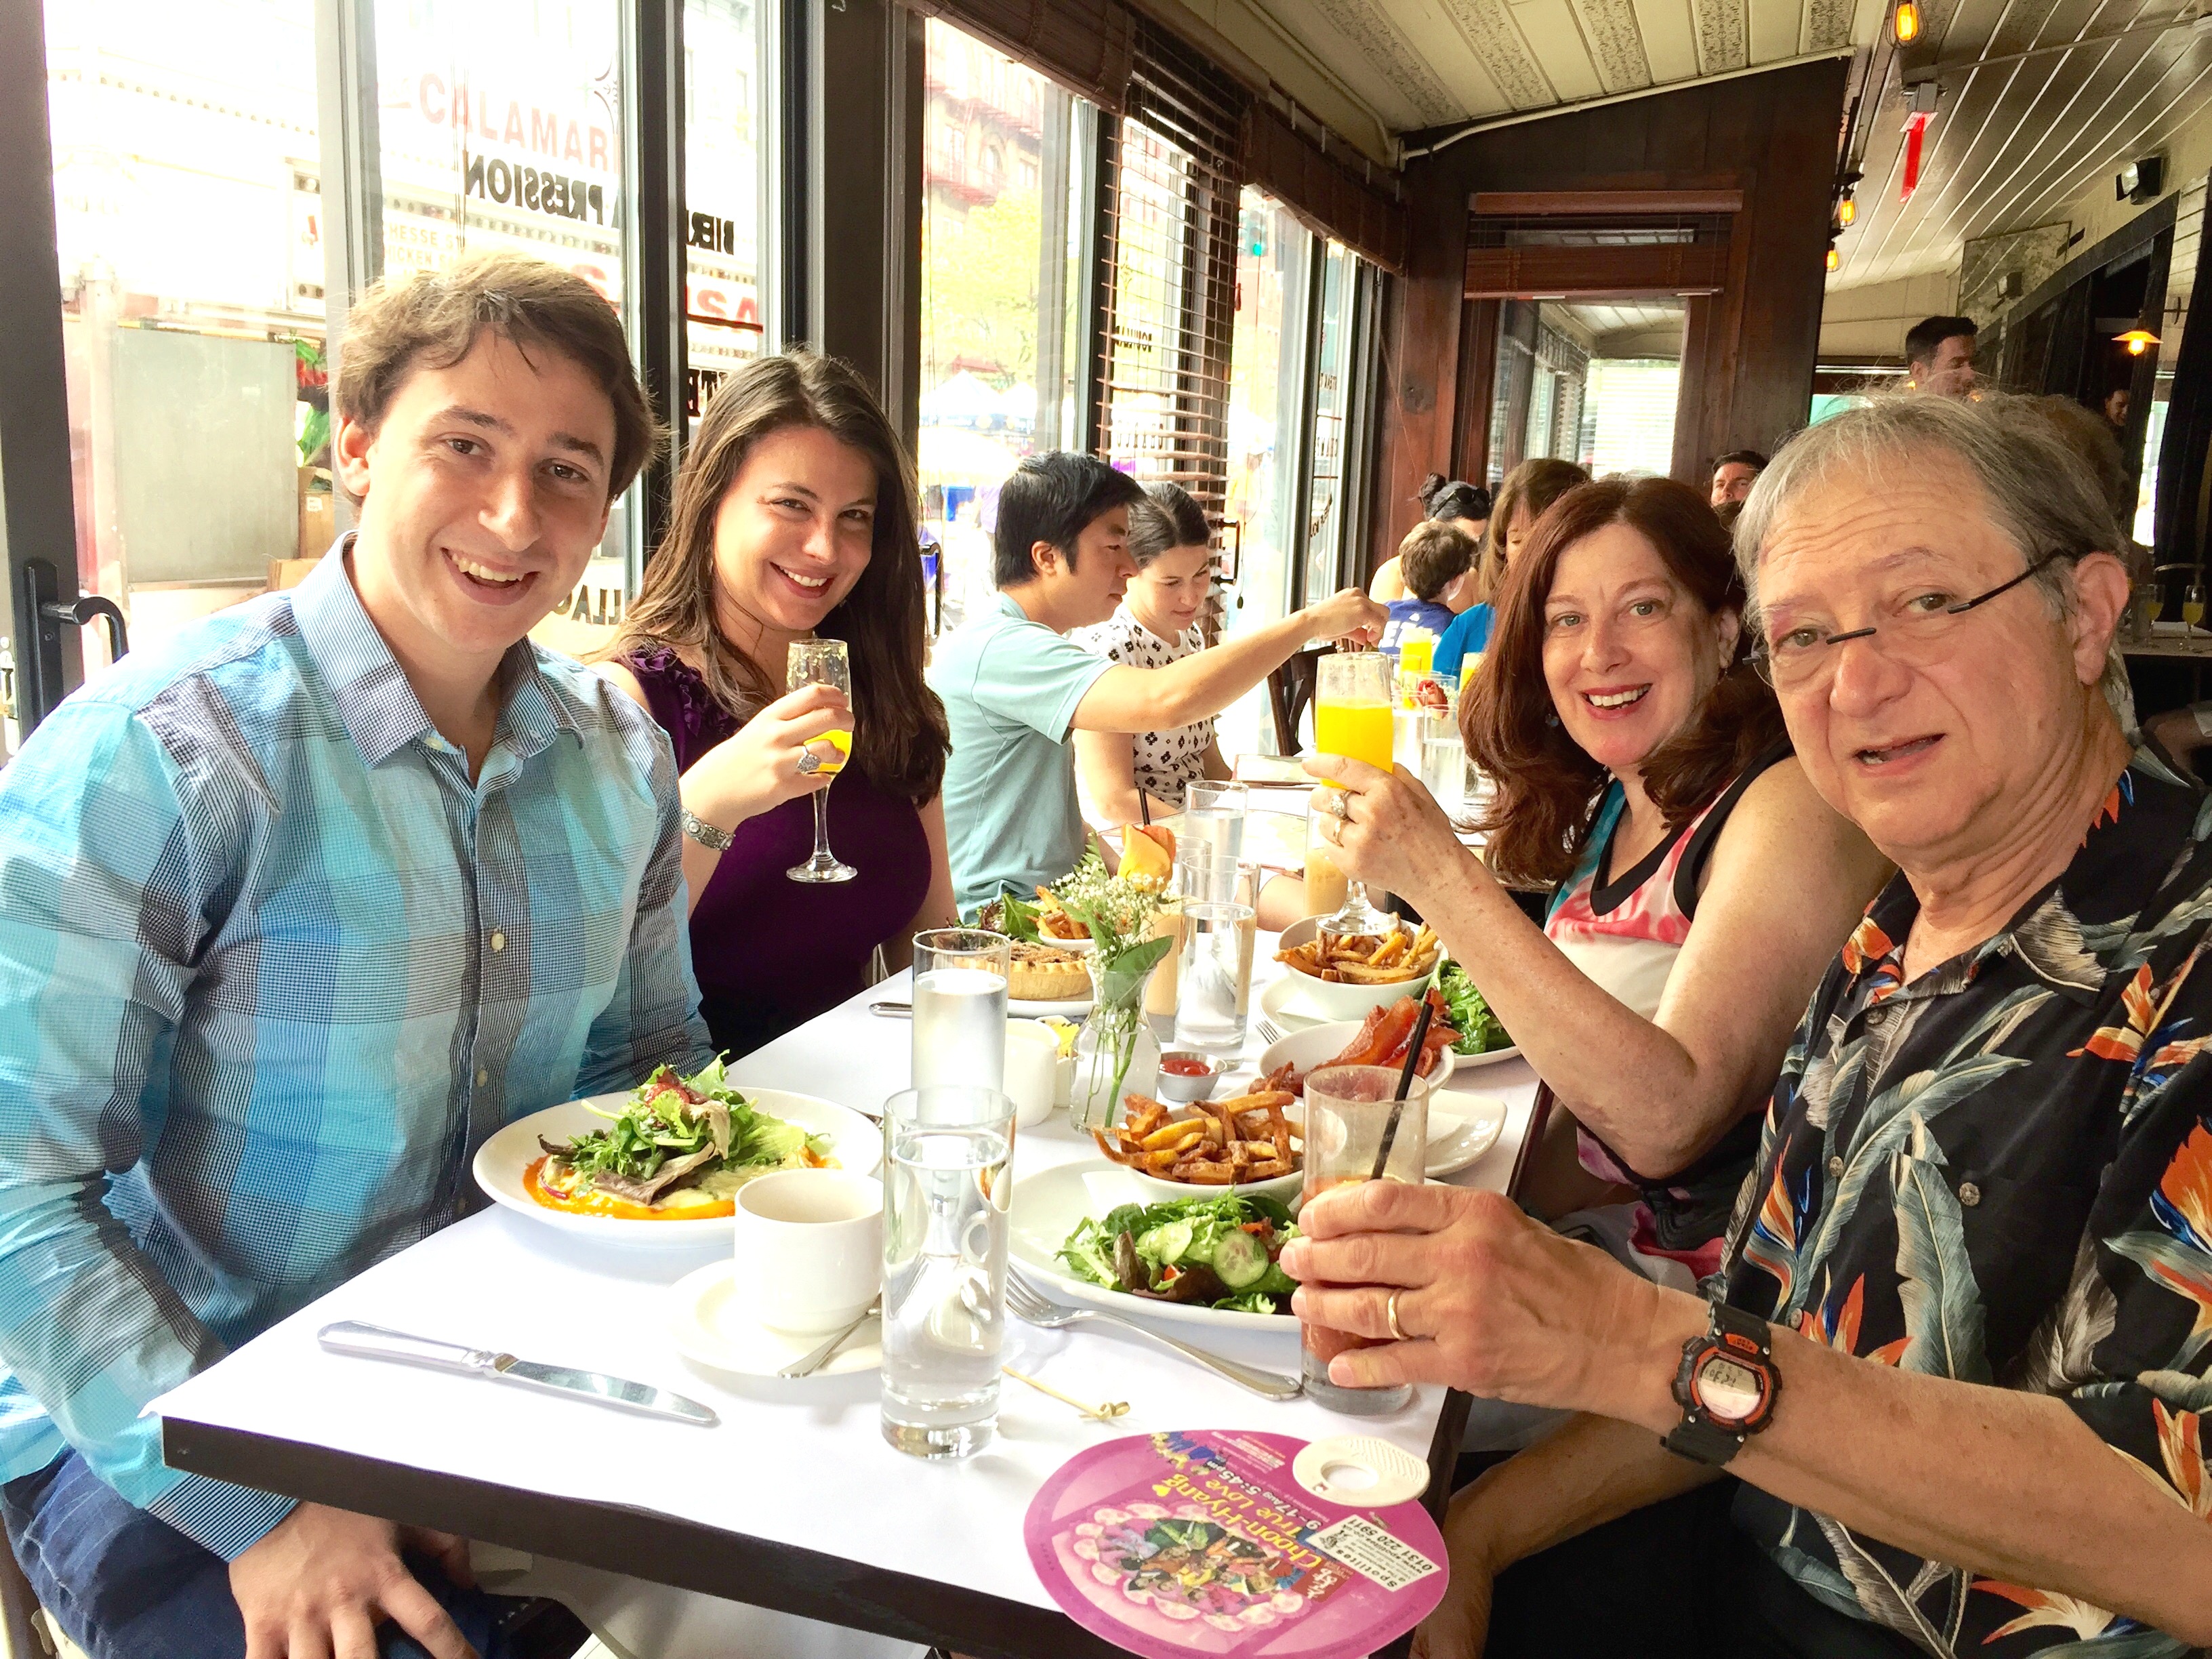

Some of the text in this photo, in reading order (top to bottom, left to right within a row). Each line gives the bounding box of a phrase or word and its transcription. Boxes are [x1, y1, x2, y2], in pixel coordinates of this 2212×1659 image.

[1206, 1479, 1255, 1509] Love
[1162, 1473, 1322, 1568] Choon-Hyang
[1256, 1507, 1303, 1539] True
[1347, 1518, 1378, 1536] 5911
[1374, 1534, 1402, 1551] 220
[1336, 1549, 1398, 1587] Spotlites
[1398, 1549, 1435, 1571] 0131
